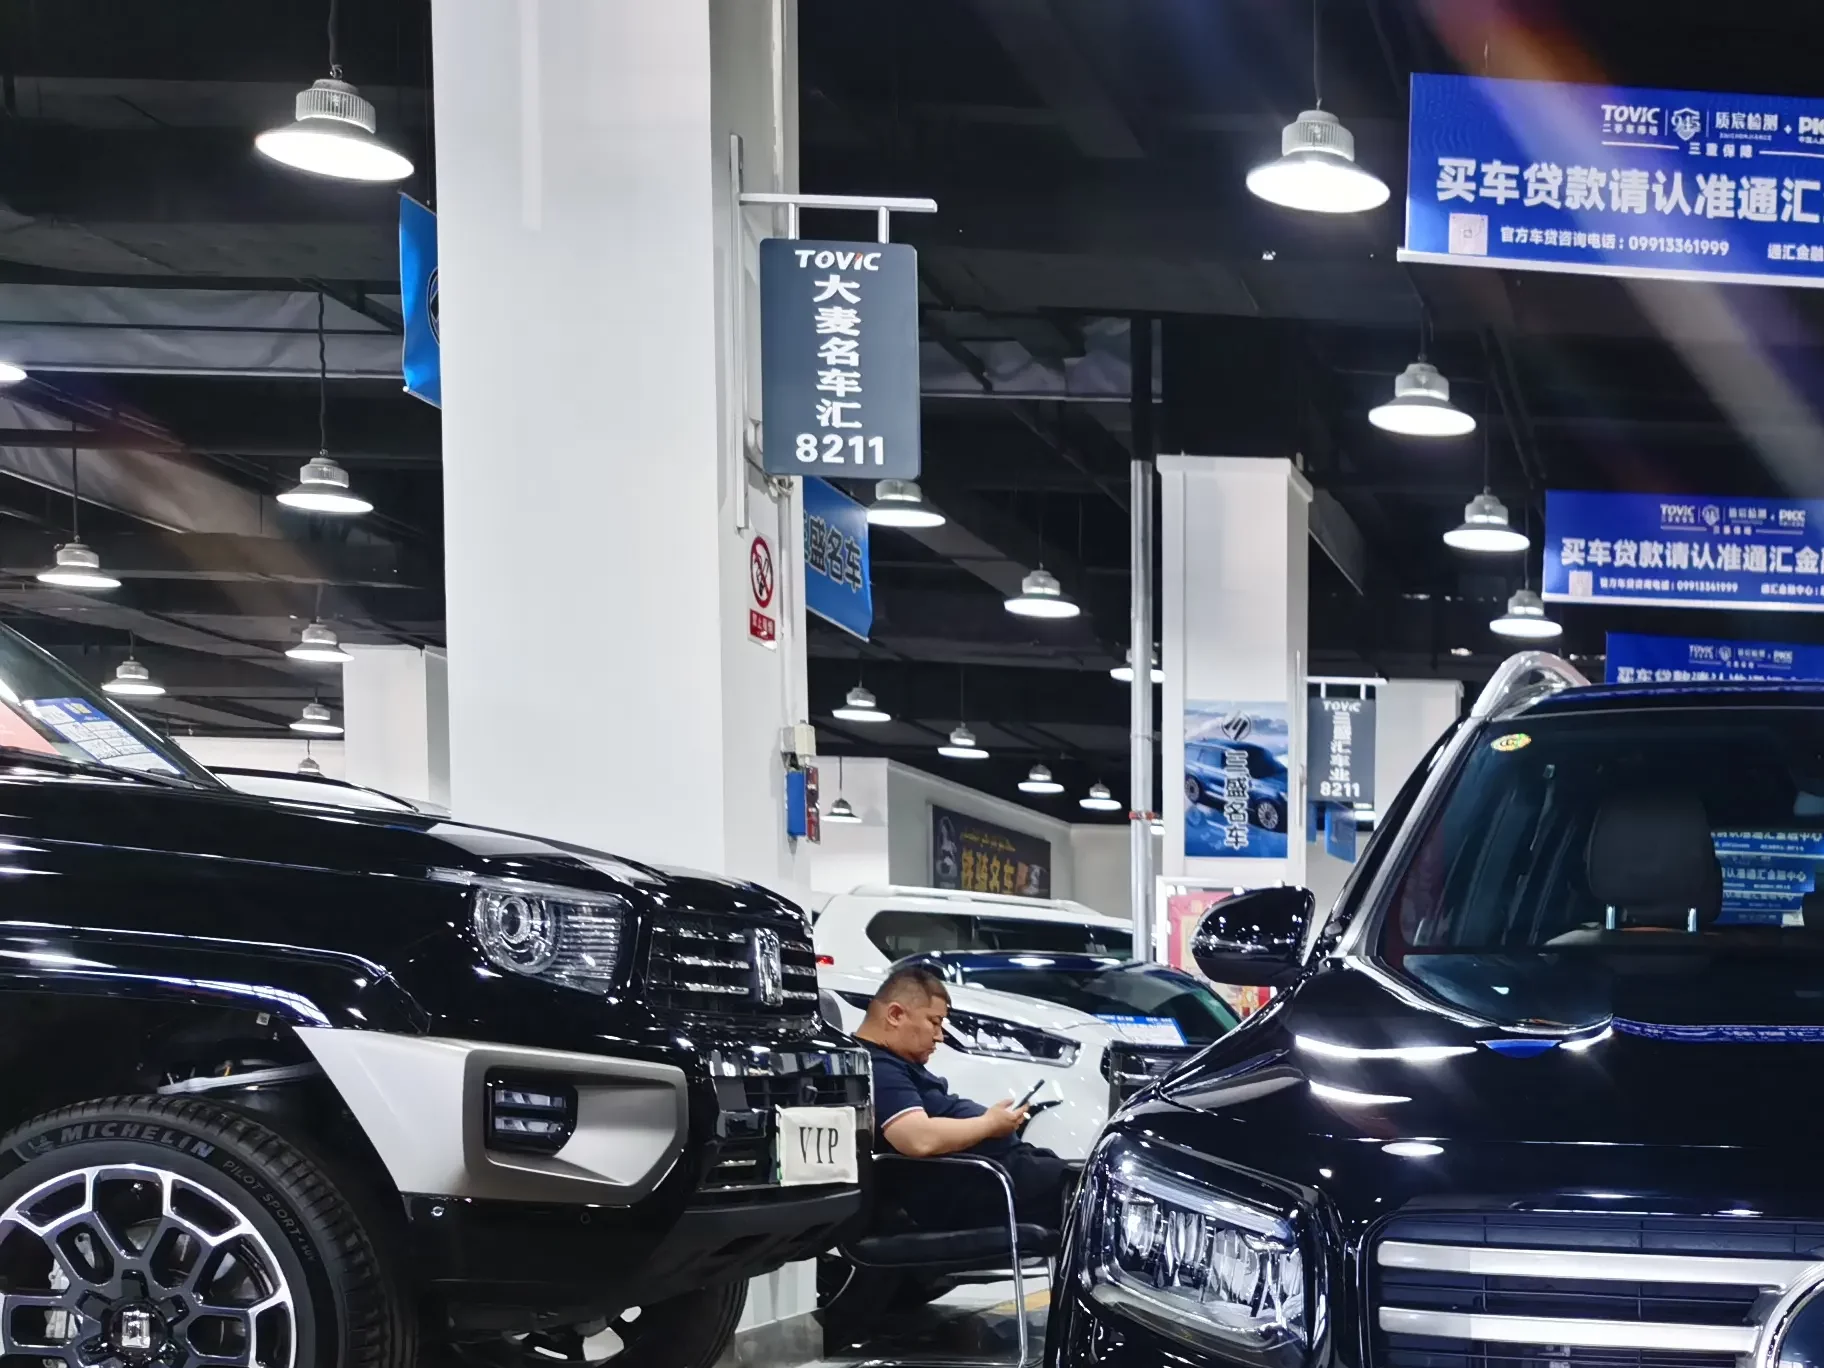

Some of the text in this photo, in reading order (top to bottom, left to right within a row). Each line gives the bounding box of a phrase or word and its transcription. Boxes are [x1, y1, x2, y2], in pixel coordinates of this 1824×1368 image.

[1601, 104, 1660, 124] TOVIC
[793, 249, 882, 271] TOVIC
[812, 273, 863, 429] 大麦名车汇
[795, 434, 885, 465] 8211
[803, 510, 862, 593] 盛名车
[1323, 700, 1362, 712] TOVIC
[1320, 781, 1360, 798] 8211
[60, 1122, 215, 1158] MICHELIN
[799, 1126, 840, 1165] VIP
[222, 1159, 265, 1190] PILOT
[262, 1192, 301, 1235] SPORT
